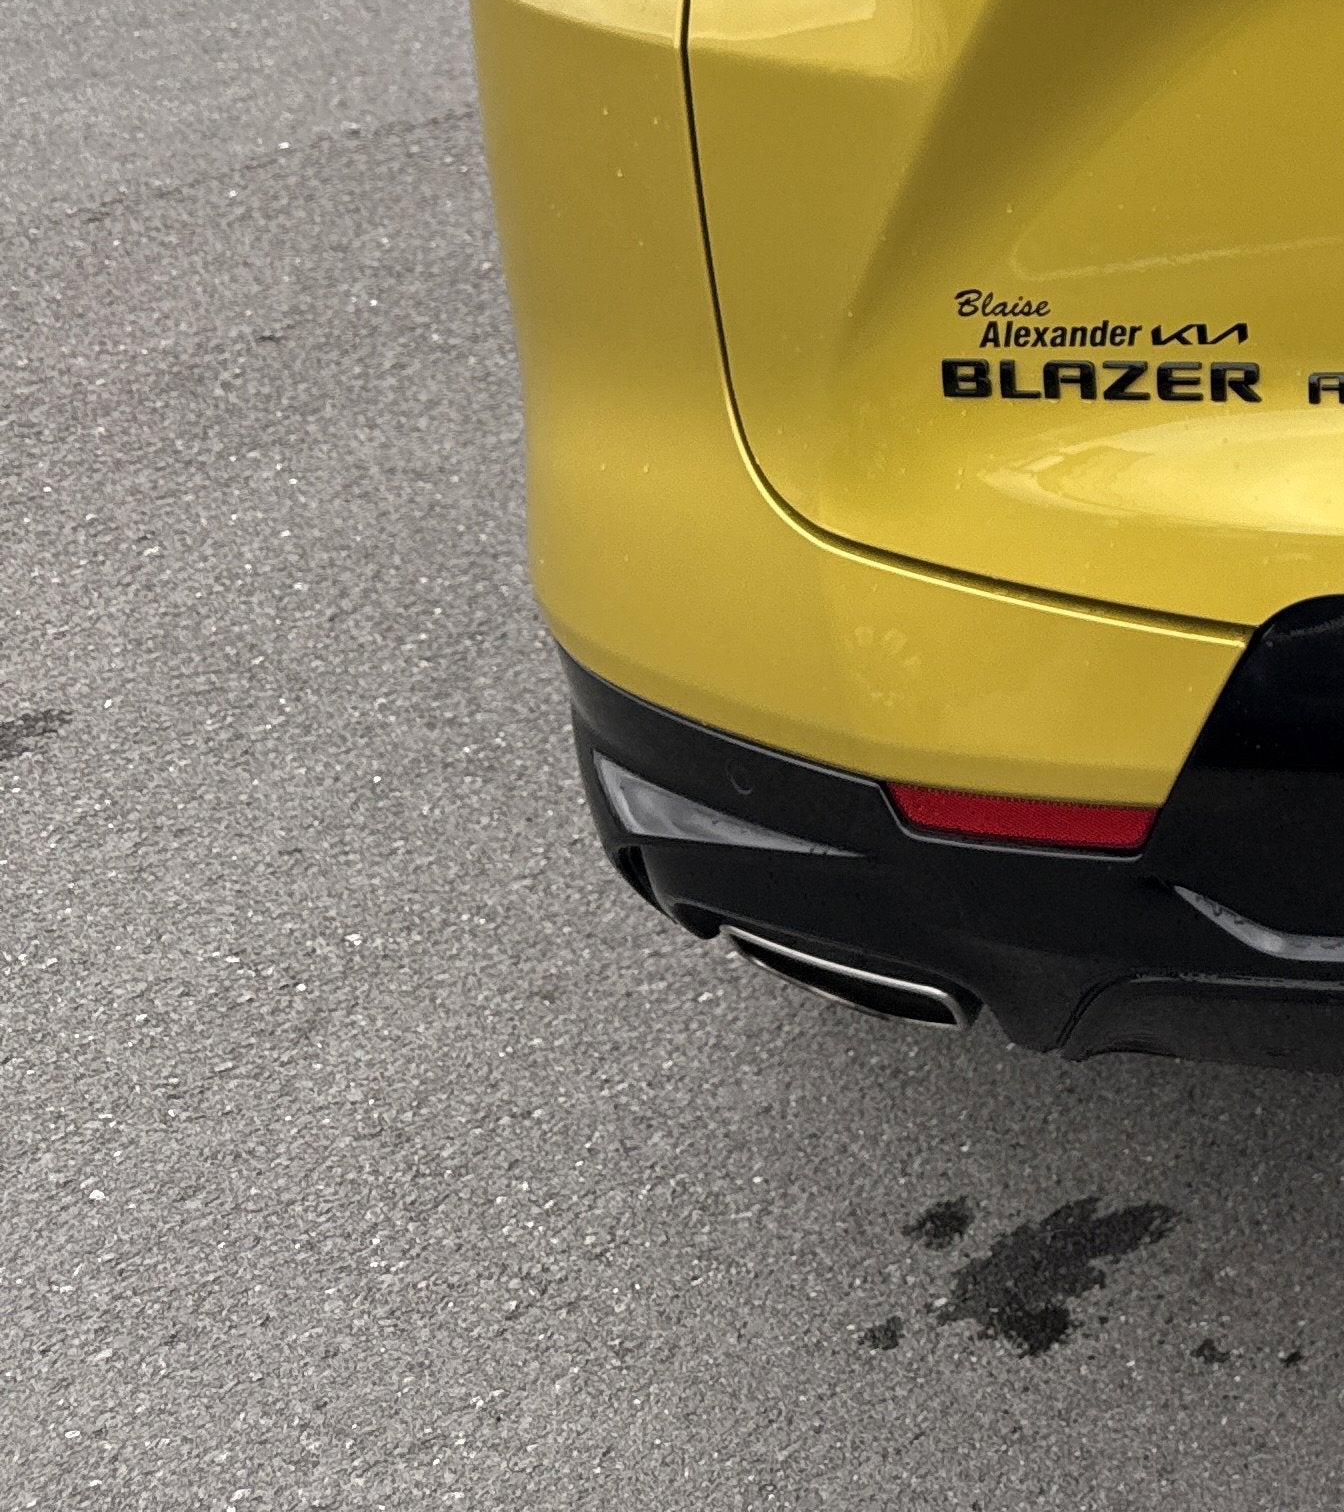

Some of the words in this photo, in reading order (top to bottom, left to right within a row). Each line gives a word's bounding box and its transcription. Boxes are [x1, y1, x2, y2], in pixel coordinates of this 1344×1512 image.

[954, 289, 1051, 318] Blaise
[979, 320, 1143, 348] Alexander
[941, 358, 1263, 402] BLAZER
